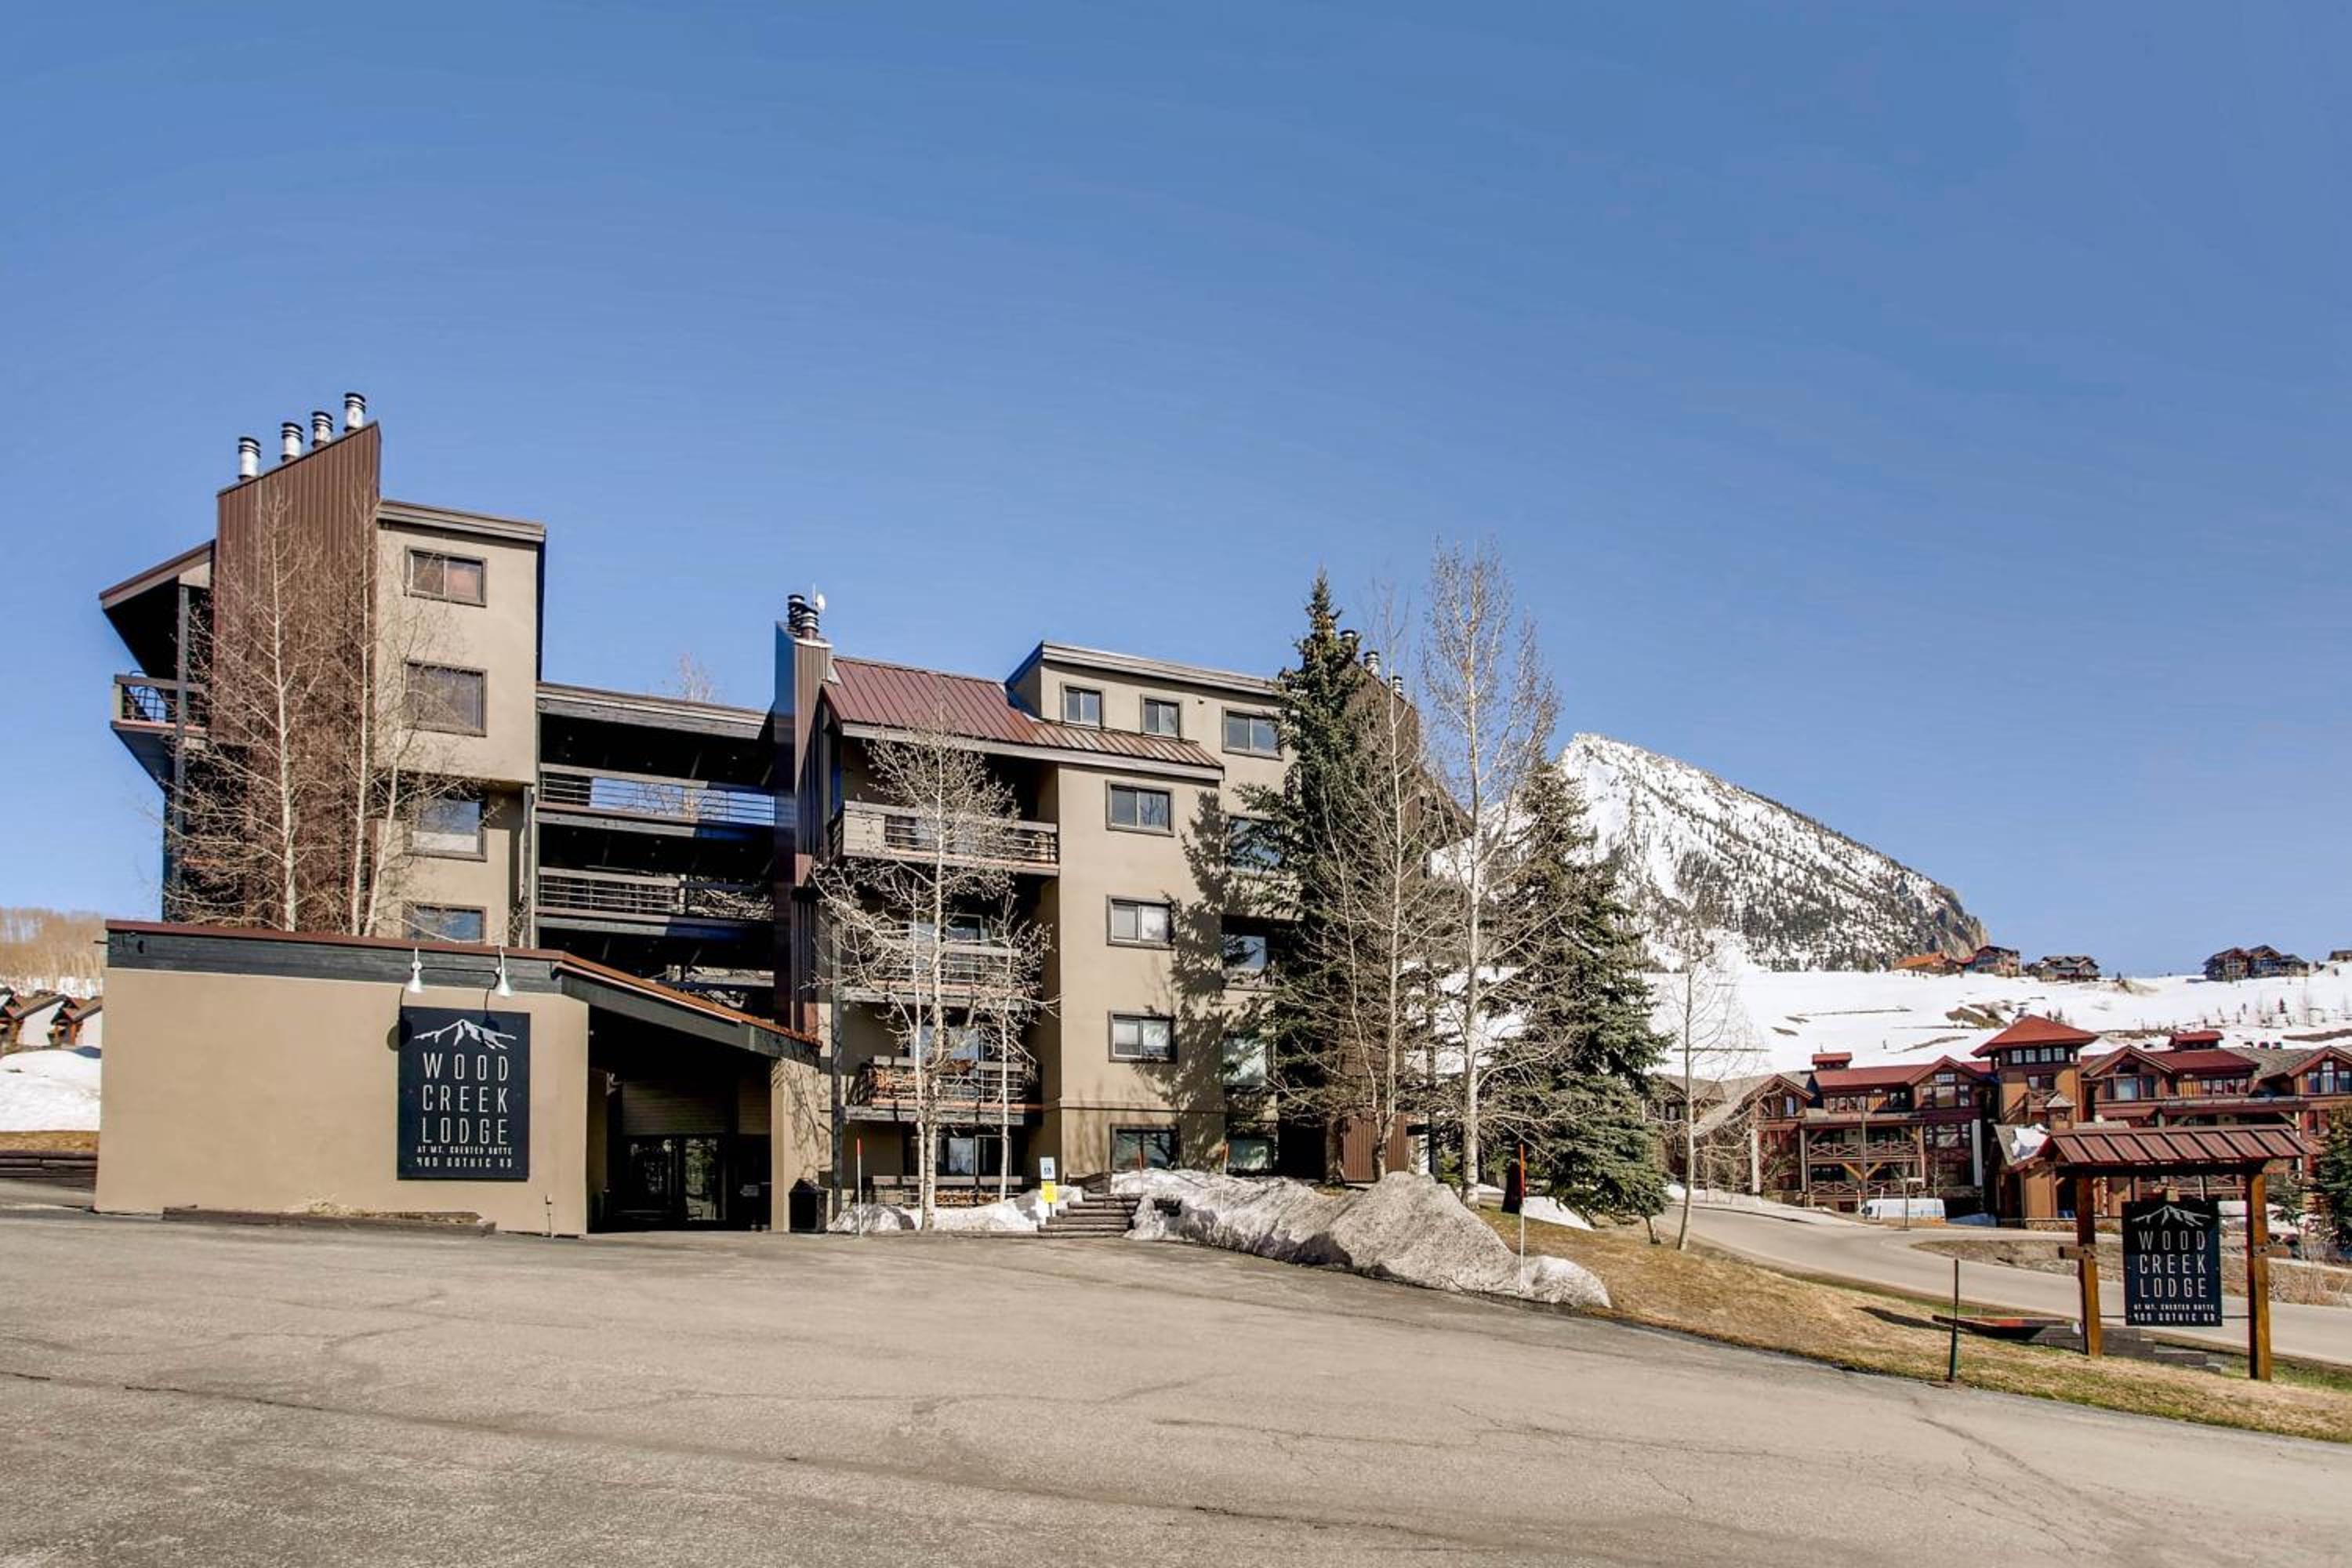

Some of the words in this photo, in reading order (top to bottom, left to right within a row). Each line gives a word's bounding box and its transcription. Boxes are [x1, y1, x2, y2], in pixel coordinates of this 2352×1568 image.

[423, 1053, 508, 1081] WOOD
[423, 1084, 508, 1113] CREEK
[423, 1117, 508, 1145] LODGE
[2138, 1230, 2205, 1250] WOOD
[2140, 1254, 2206, 1274] CREEK
[2140, 1277, 2207, 1298] LODGE
